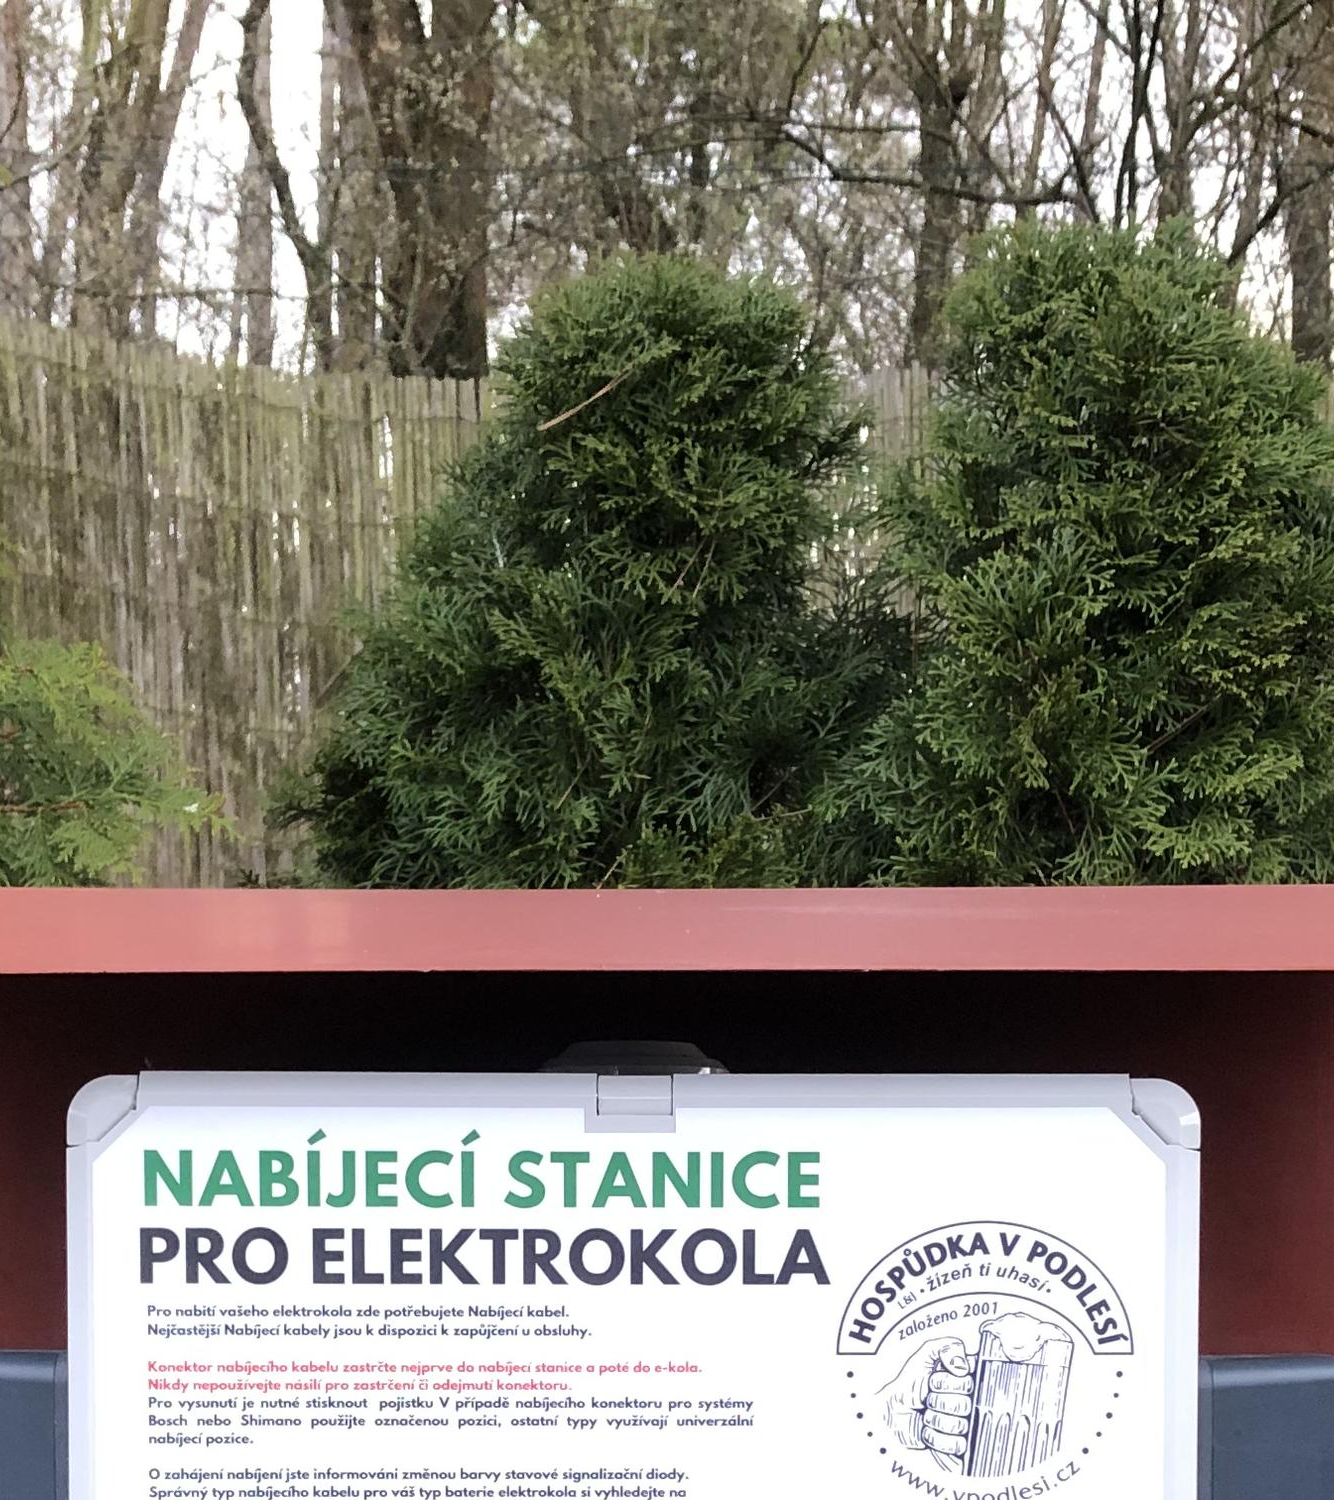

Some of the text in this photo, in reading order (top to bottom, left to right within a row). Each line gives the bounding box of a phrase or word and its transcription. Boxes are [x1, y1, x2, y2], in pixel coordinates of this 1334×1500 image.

[144, 1129, 820, 1209] NABÍJECÍ STANICE
[139, 1226, 830, 1286] PRO ELEKTROKOLA
[978, 1262, 992, 1277] ti
[847, 1231, 1130, 1346] HOSPŮDKA V PODLESÍ
[147, 1304, 570, 1321] Pro nabití vašeho elektrokola zde potřebujete Nabíjecí kabel.
[897, 1300, 1000, 1342] založeno 2001
[147, 1323, 592, 1340] Nejčastější Nabíjecí kabely jsou k dispozici k zapůjčení u obsluhy.
[147, 1360, 702, 1376] Konektor nabíjecího kabelu zastrčte nejprve do nabíjecí stanice a poté do e-kola.
[148, 1378, 572, 1394] Nikdy nepoužívejte násilí pro zastrčení či odejmutí konektoru.
[148, 1396, 754, 1413] Pro vysunutí je nutné stisknout pojistku V případě nabíjecího konektoru pro systémy
[148, 1413, 754, 1430] Bosch nebo Shimano použijte označenou pozici, ostatní typy využívají univerzální
[148, 1432, 254, 1448] nabíjecí pozice.
[148, 1468, 161, 1481] O
[163, 1467, 224, 1483] zahájení
[226, 1467, 284, 1484] nabíjení
[284, 1468, 311, 1484] jste
[401, 1467, 457, 1481] změnou
[459, 1467, 502, 1483] barvy
[504, 1469, 560, 1481] stavové
[561, 1467, 645, 1484] signalizační
[645, 1467, 690, 1484] diody.
[149, 1485, 209, 1500] Správný
[238, 1485, 309, 1500] nabíjecího
[312, 1485, 360, 1498] kabelu
[363, 1489, 388, 1500] pro
[391, 1485, 416, 1498] váš
[418, 1487, 442, 1500] typ
[445, 1485, 495, 1498] baterie
[498, 1485, 577, 1498] elektrokola
[580, 1486, 591, 1498] si
[594, 1485, 666, 1500] vyhledejte
[669, 1489, 687, 1498] na
